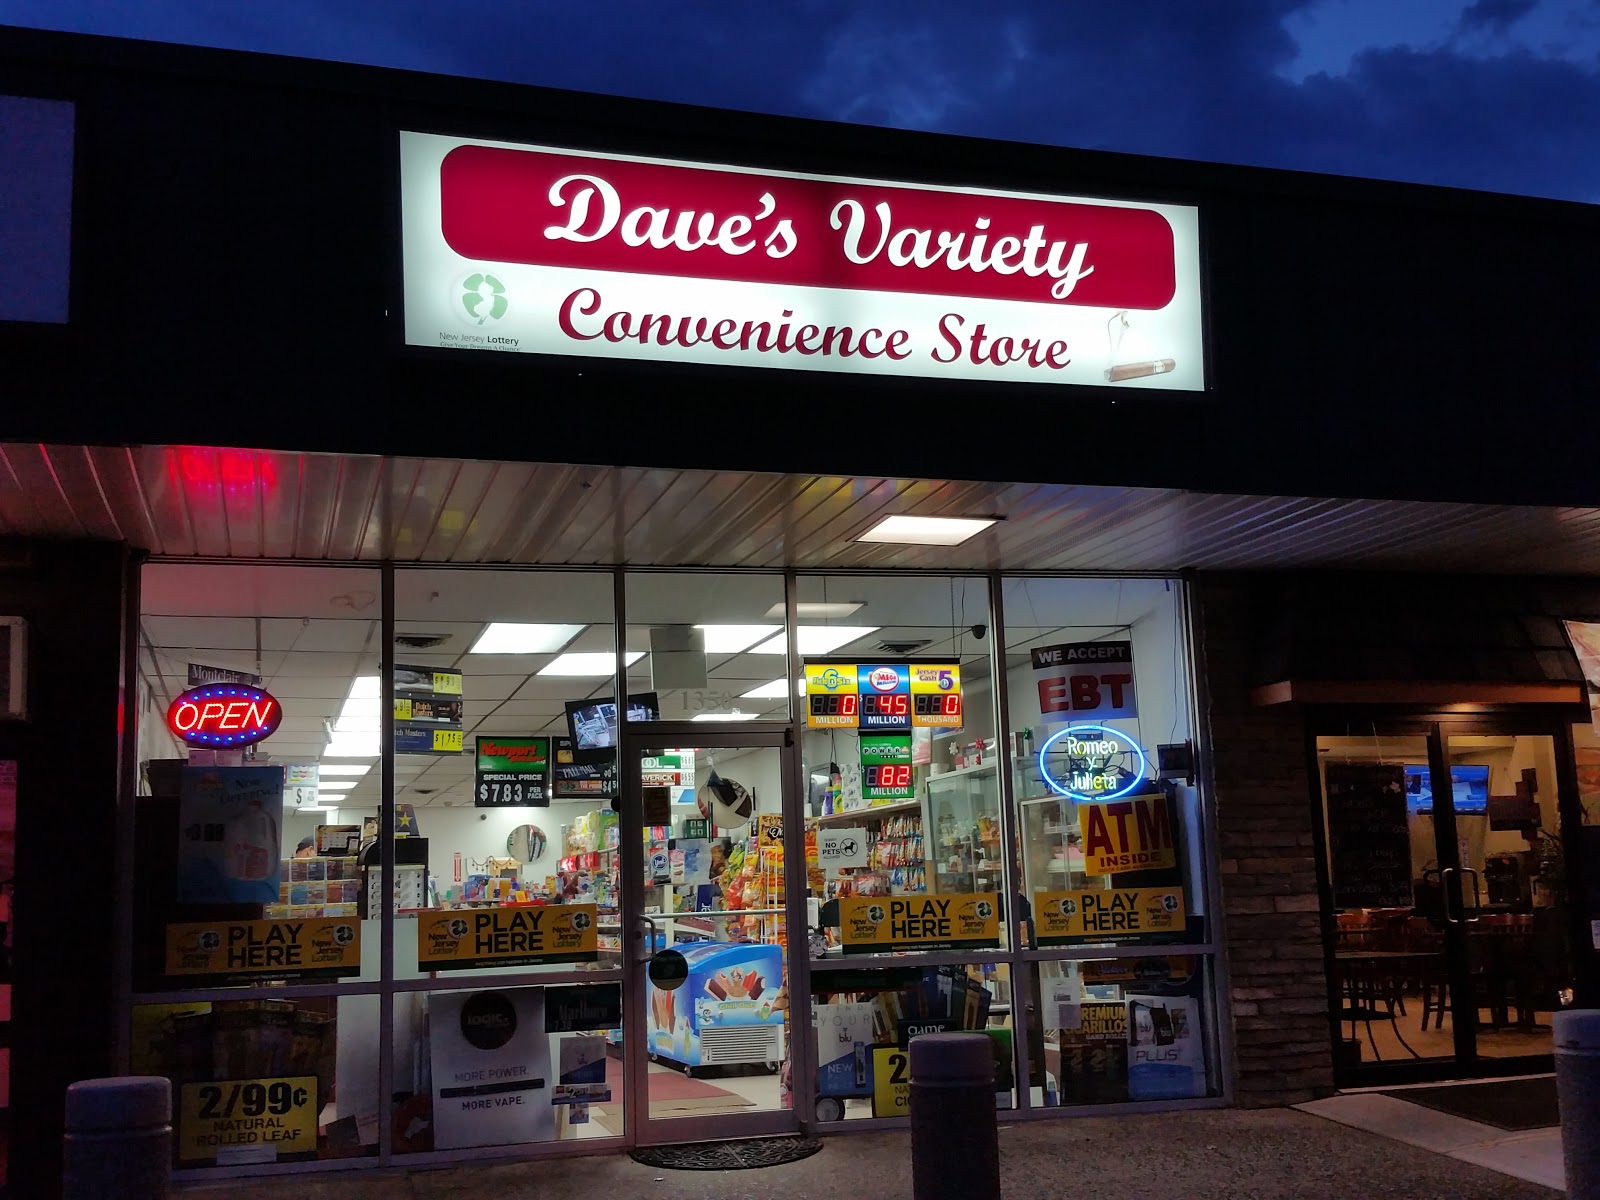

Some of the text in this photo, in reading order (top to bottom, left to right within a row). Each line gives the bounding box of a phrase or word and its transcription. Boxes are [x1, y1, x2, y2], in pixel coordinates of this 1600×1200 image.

[542, 173, 1095, 300] Dave's Variety
[557, 286, 1072, 371] Convenience Store
[440, 332, 519, 347] New Jersey Lottery
[1038, 646, 1125, 664] WE ACCEPT
[1037, 674, 1132, 714] EBT
[880, 695, 907, 715] 45
[174, 701, 273, 731] OPEN
[815, 716, 854, 724] MILLION
[867, 716, 906, 724] MILLION
[479, 742, 537, 758] Newport
[1066, 736, 1119, 755] Romeo
[642, 757, 663, 768] OOL
[881, 766, 910, 785] 82
[1070, 771, 1118, 791] Julieta
[870, 788, 908, 796] MILLION
[1086, 800, 1172, 857] ATM
[1100, 851, 1162, 868] INSIDE
[891, 899, 951, 919] PLAY
[1081, 892, 1139, 912] PLAY
[475, 910, 545, 933] PLAY
[854, 924, 878, 932] Jersey
[891, 918, 951, 938] HERE
[962, 920, 986, 928] Jersey
[1082, 911, 1140, 931] HERE
[228, 923, 304, 946] PLAY
[428, 933, 448, 941] New
[552, 926, 571, 934] New
[557, 932, 583, 941] Jersey
[312, 939, 333, 947] New
[433, 940, 460, 949] Jersey
[475, 931, 544, 954] HERE
[228, 944, 302, 968] HERE
[820, 1014, 870, 1027] YOUR
[839, 1033, 852, 1043] blu
[1136, 1050, 1178, 1062] PLUS
[455, 1065, 530, 1082] MORE POWER.
[827, 1064, 853, 1074] NEW
[199, 1082, 308, 1120] 2/99¢
[462, 1095, 525, 1110] MORE VAPE.
[213, 1116, 286, 1132] NATURAL
[262, 1128, 302, 1142] LEAF
